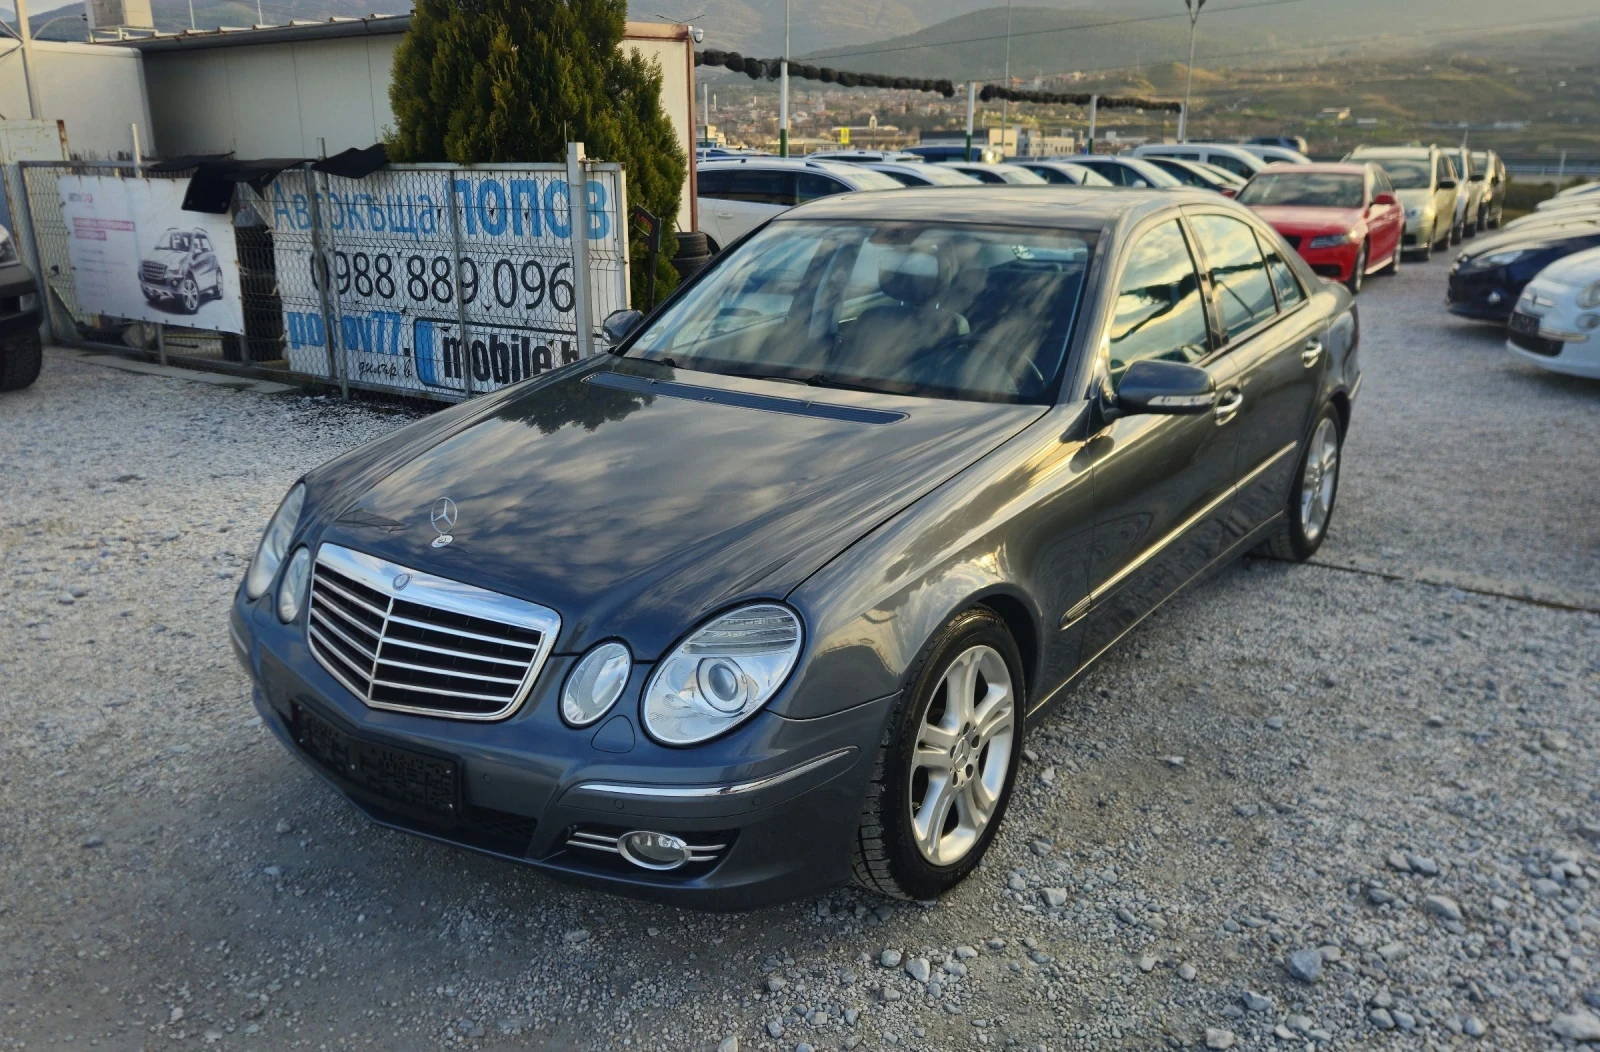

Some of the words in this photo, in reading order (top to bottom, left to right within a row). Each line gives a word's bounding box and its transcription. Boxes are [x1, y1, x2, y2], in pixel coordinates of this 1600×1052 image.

[311, 251, 395, 299] 0988
[407, 255, 478, 304] 889
[493, 258, 575, 312] 096
